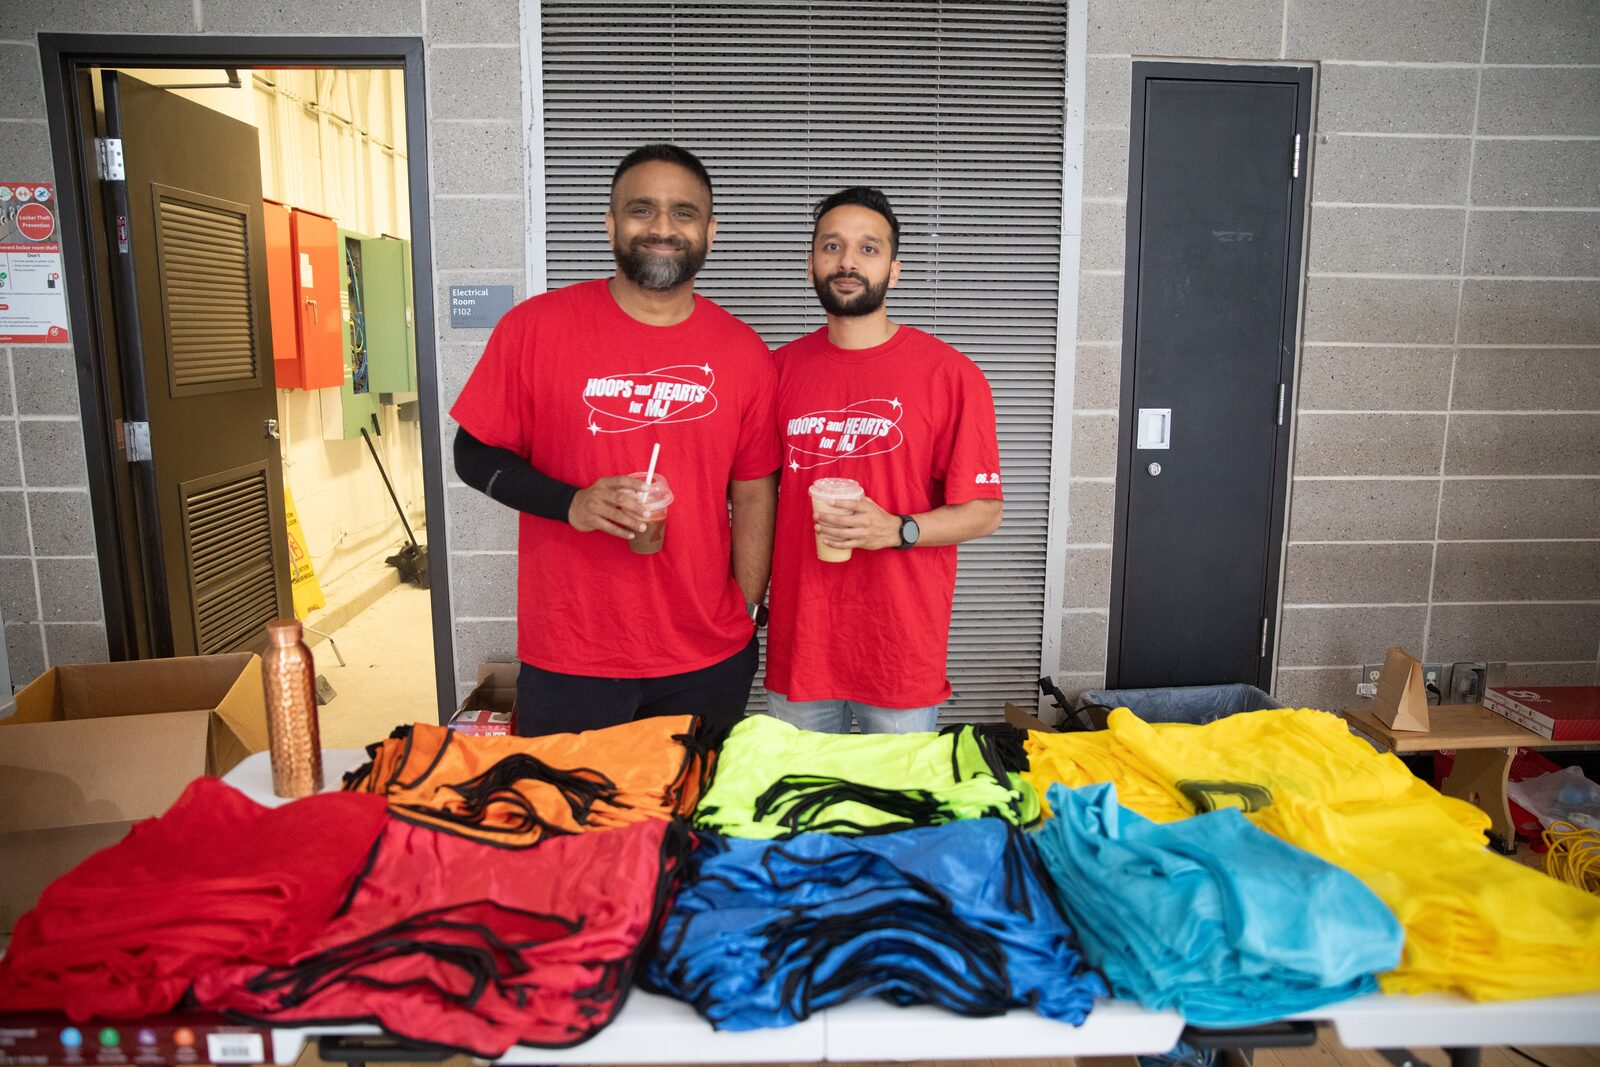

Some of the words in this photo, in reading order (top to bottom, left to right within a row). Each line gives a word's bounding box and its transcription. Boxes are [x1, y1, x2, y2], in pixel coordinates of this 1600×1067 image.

[453, 308, 471, 316] F102
[584, 378, 634, 398] HOOPS
[634, 384, 653, 396] and
[653, 382, 708, 403] HEARTS
[628, 401, 644, 414] for
[644, 399, 671, 417] MJ
[787, 417, 826, 436] HOOPS
[826, 421, 845, 432] and
[844, 418, 892, 437] HEARTS
[819, 437, 836, 449] for
